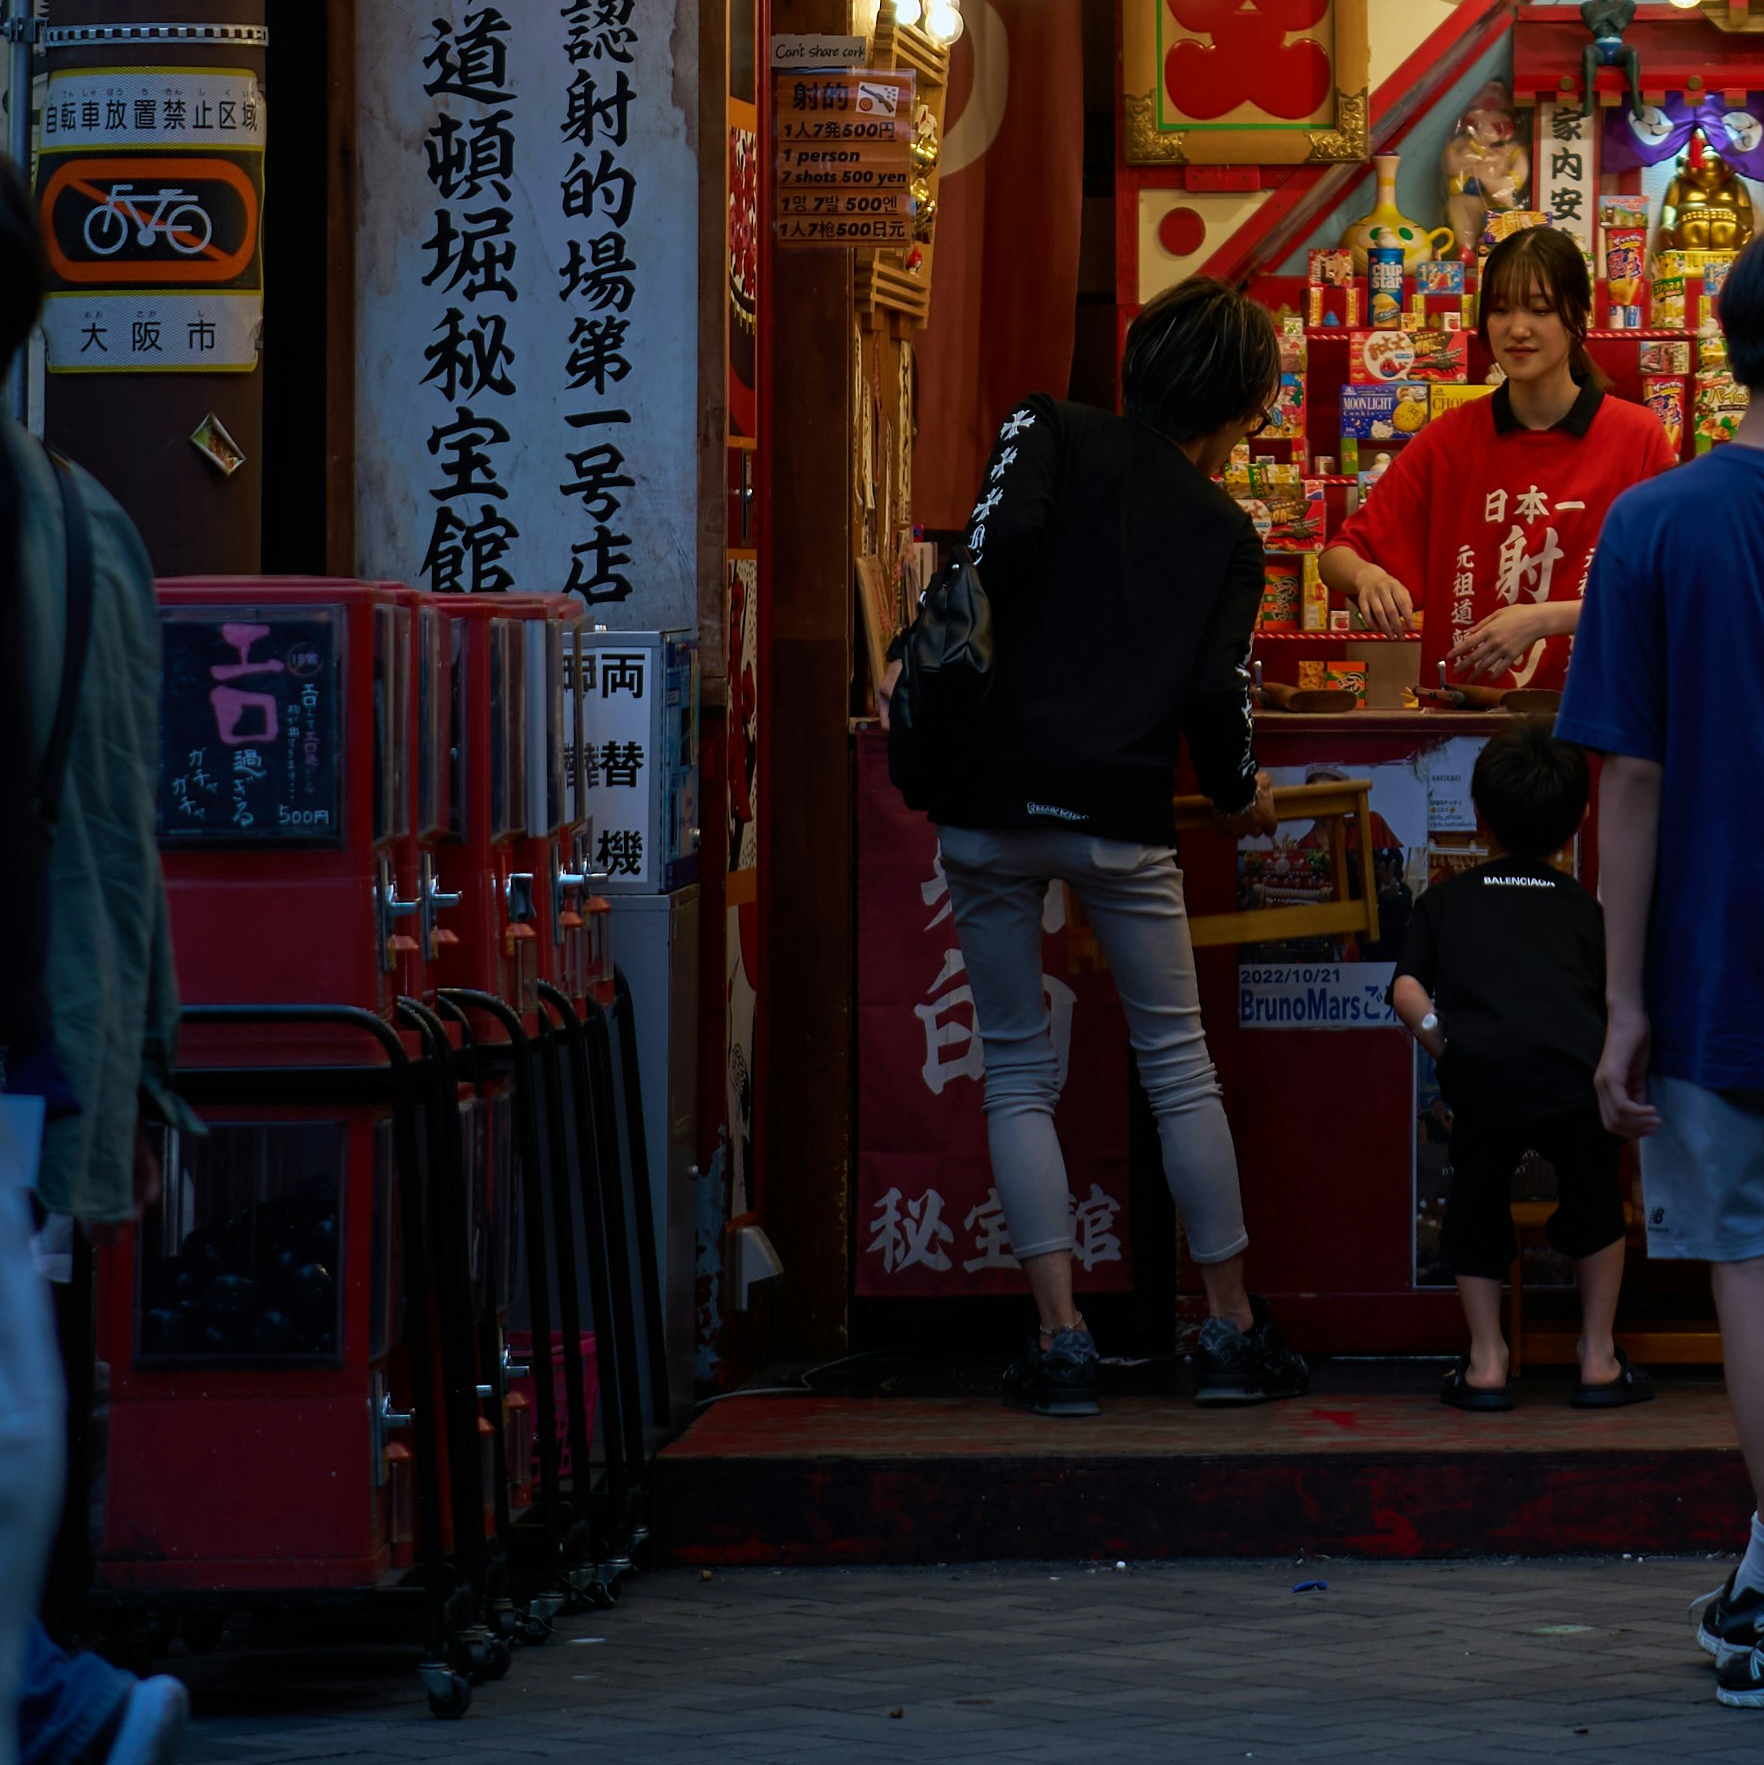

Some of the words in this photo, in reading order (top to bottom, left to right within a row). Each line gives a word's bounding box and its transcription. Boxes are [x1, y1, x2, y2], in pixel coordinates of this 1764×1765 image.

[808, 44, 840, 58] share
[792, 80, 850, 112] 射的
[46, 99, 259, 134] 自転車放置禁止区域
[783, 149, 794, 162] 1
[797, 148, 861, 166] person
[781, 170, 792, 183] 7
[795, 170, 838, 183] shots
[841, 170, 874, 183] 500
[877, 170, 907, 188] yen
[1372, 262, 1403, 277] chip
[1372, 276, 1403, 289] star
[80, 321, 217, 354] 大阪市
[1343, 397, 1393, 410] MOONLIGHT
[1484, 484, 1586, 524] 日本一
[209, 622, 285, 745] エロ
[596, 654, 645, 875] 両替機
[1483, 875, 1557, 888] BALENCIAGA
[1239, 969, 1341, 984] 2022/10/21
